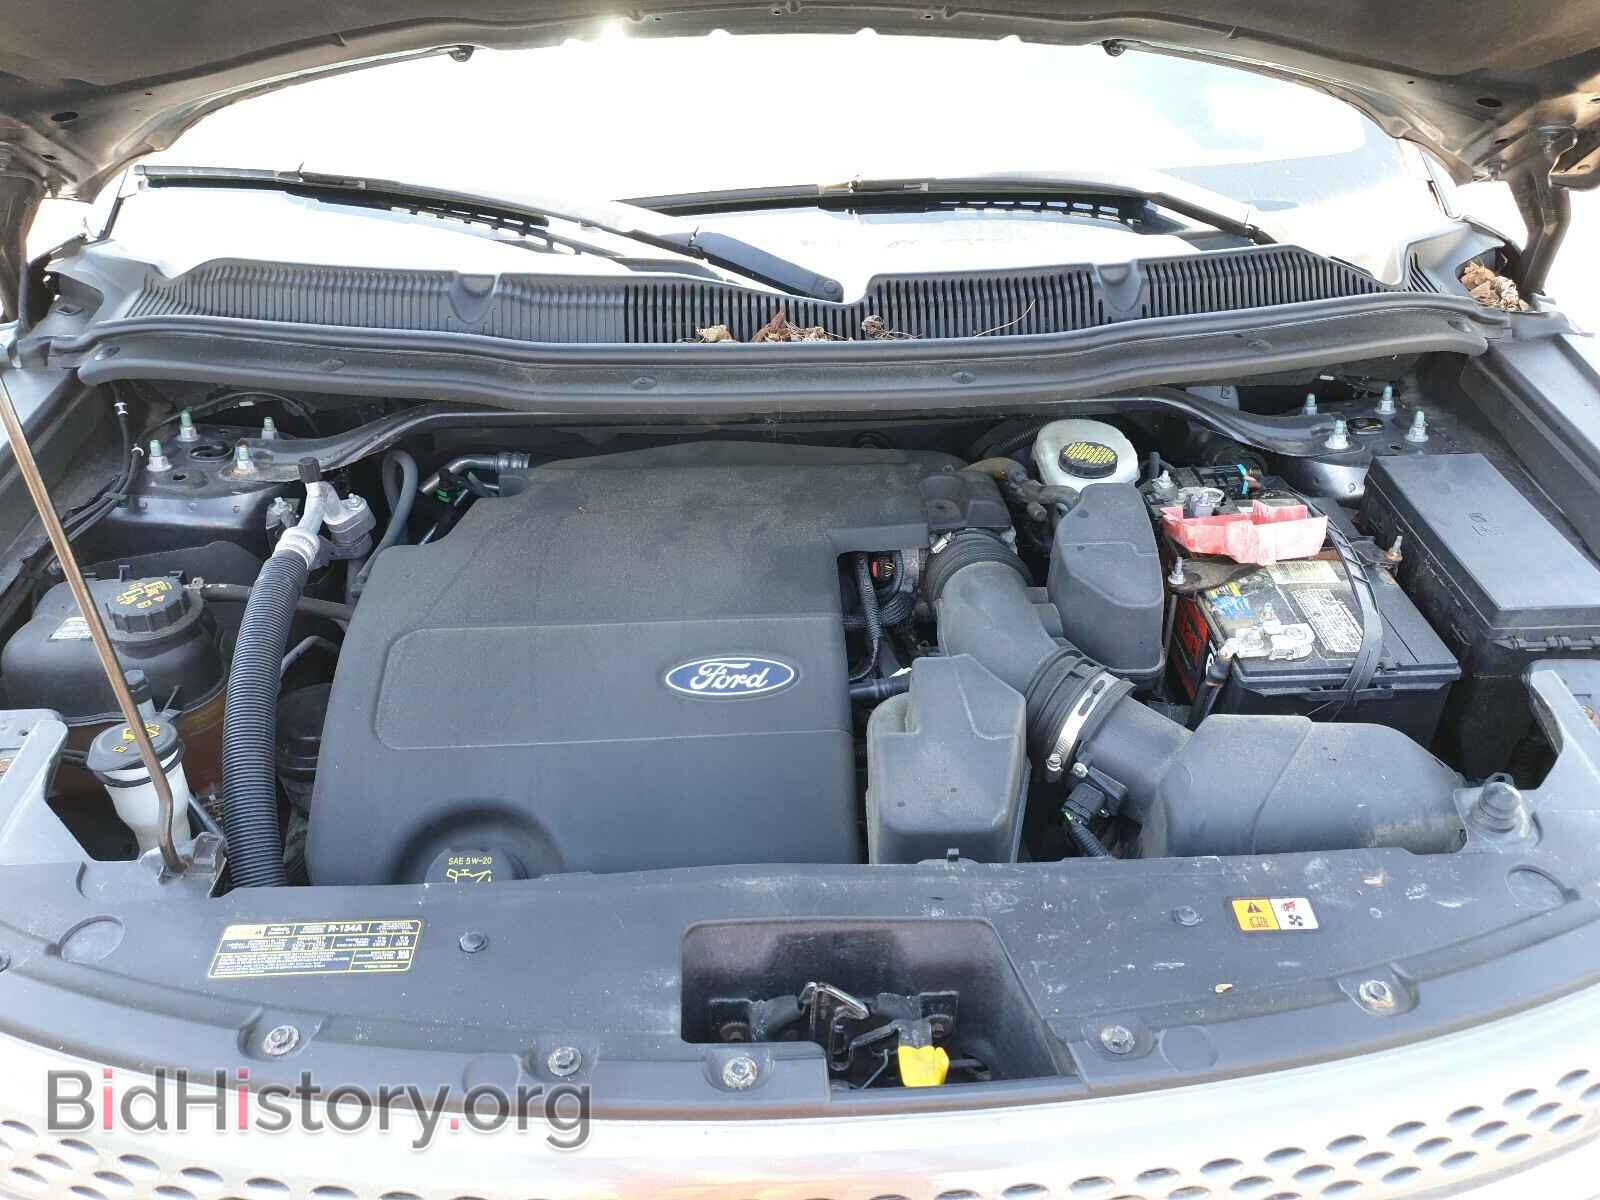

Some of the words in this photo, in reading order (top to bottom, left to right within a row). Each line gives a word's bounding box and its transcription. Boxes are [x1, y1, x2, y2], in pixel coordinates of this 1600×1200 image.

[690, 662, 770, 690] Ford
[448, 856, 464, 865] SAE
[466, 855, 492, 865] 5W-20
